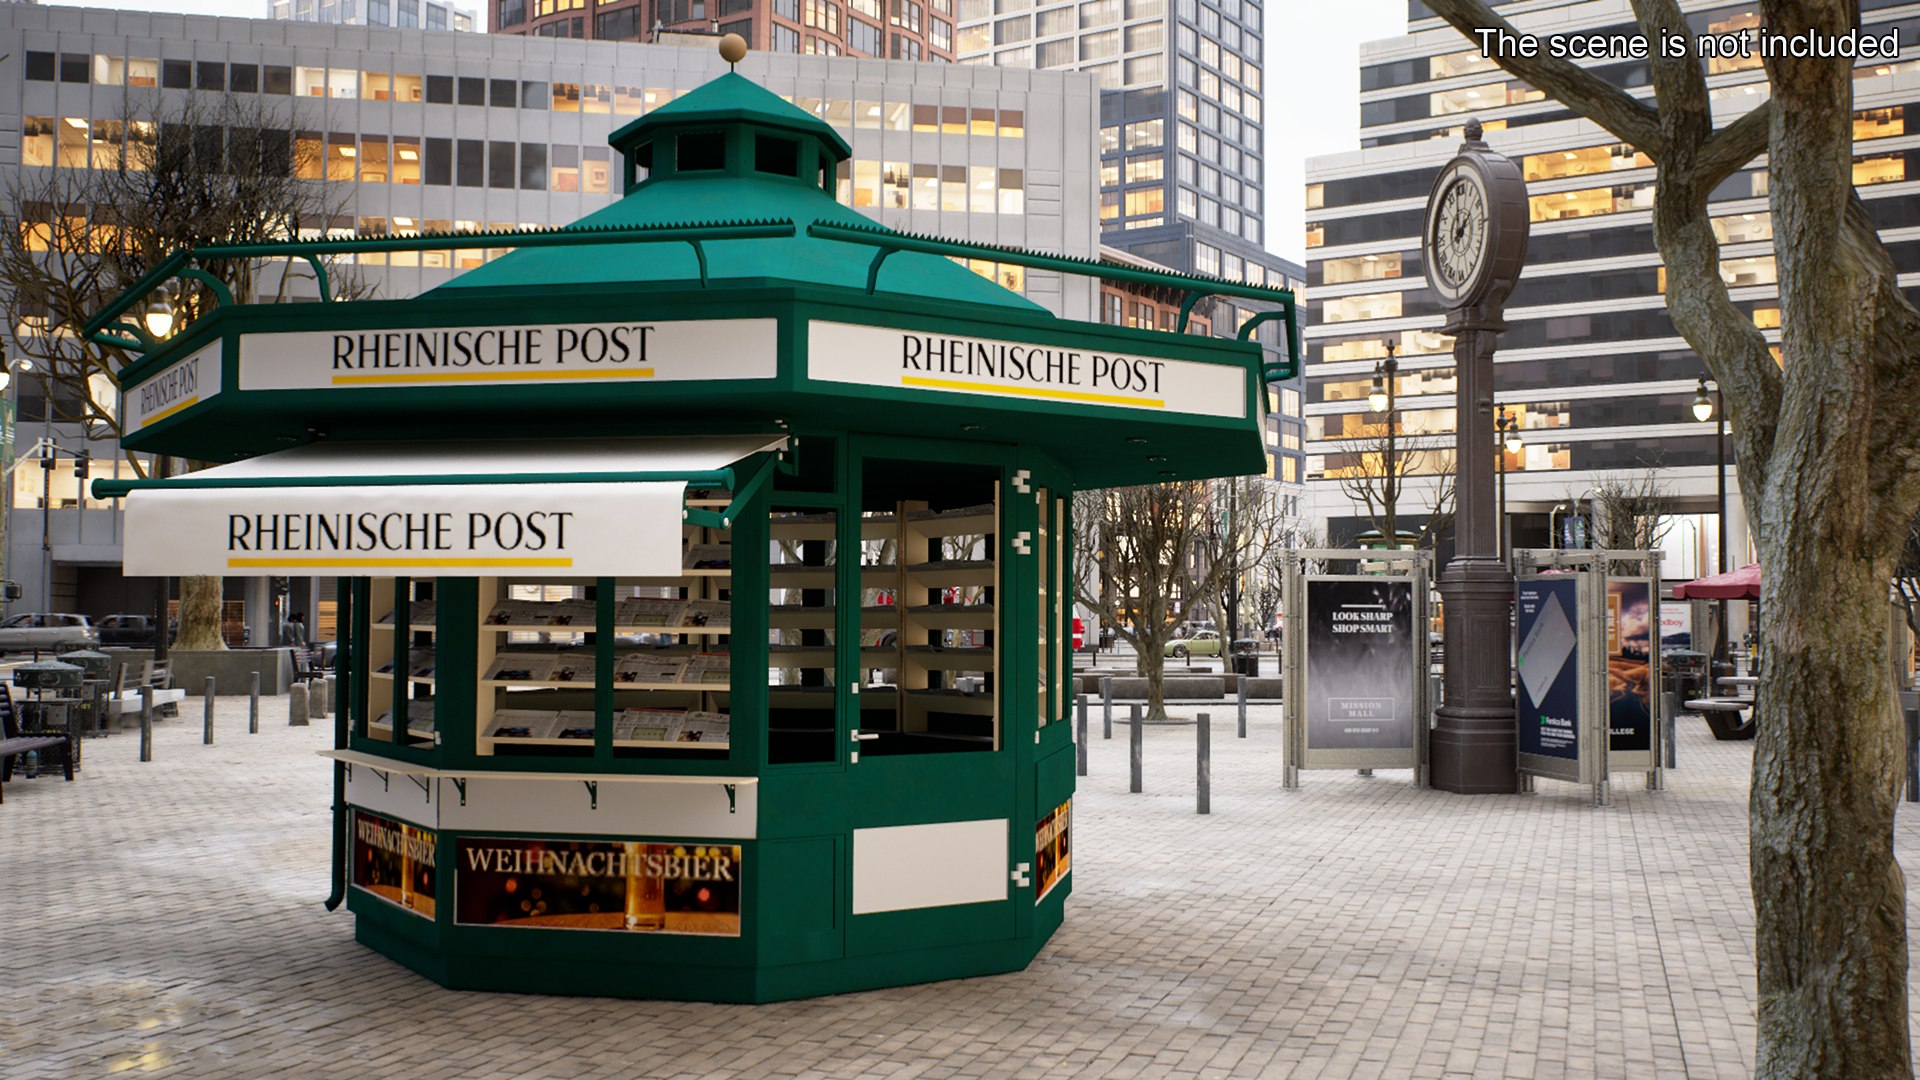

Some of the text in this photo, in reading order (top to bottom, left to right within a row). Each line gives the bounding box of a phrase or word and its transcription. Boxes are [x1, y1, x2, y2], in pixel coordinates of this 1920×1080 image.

[332, 326, 655, 369] RHEINISCHE POST
[902, 335, 1165, 393] RHEINISCHE POST
[179, 357, 199, 397] POST
[228, 511, 573, 551] RHEINISCHE POST
[1332, 612, 1393, 621] LOOK SHARP
[1332, 624, 1393, 633] SHOP SMART
[358, 818, 435, 868] WEIHNACHTSBIER
[466, 848, 733, 881] WEIHNACHTSBIER
